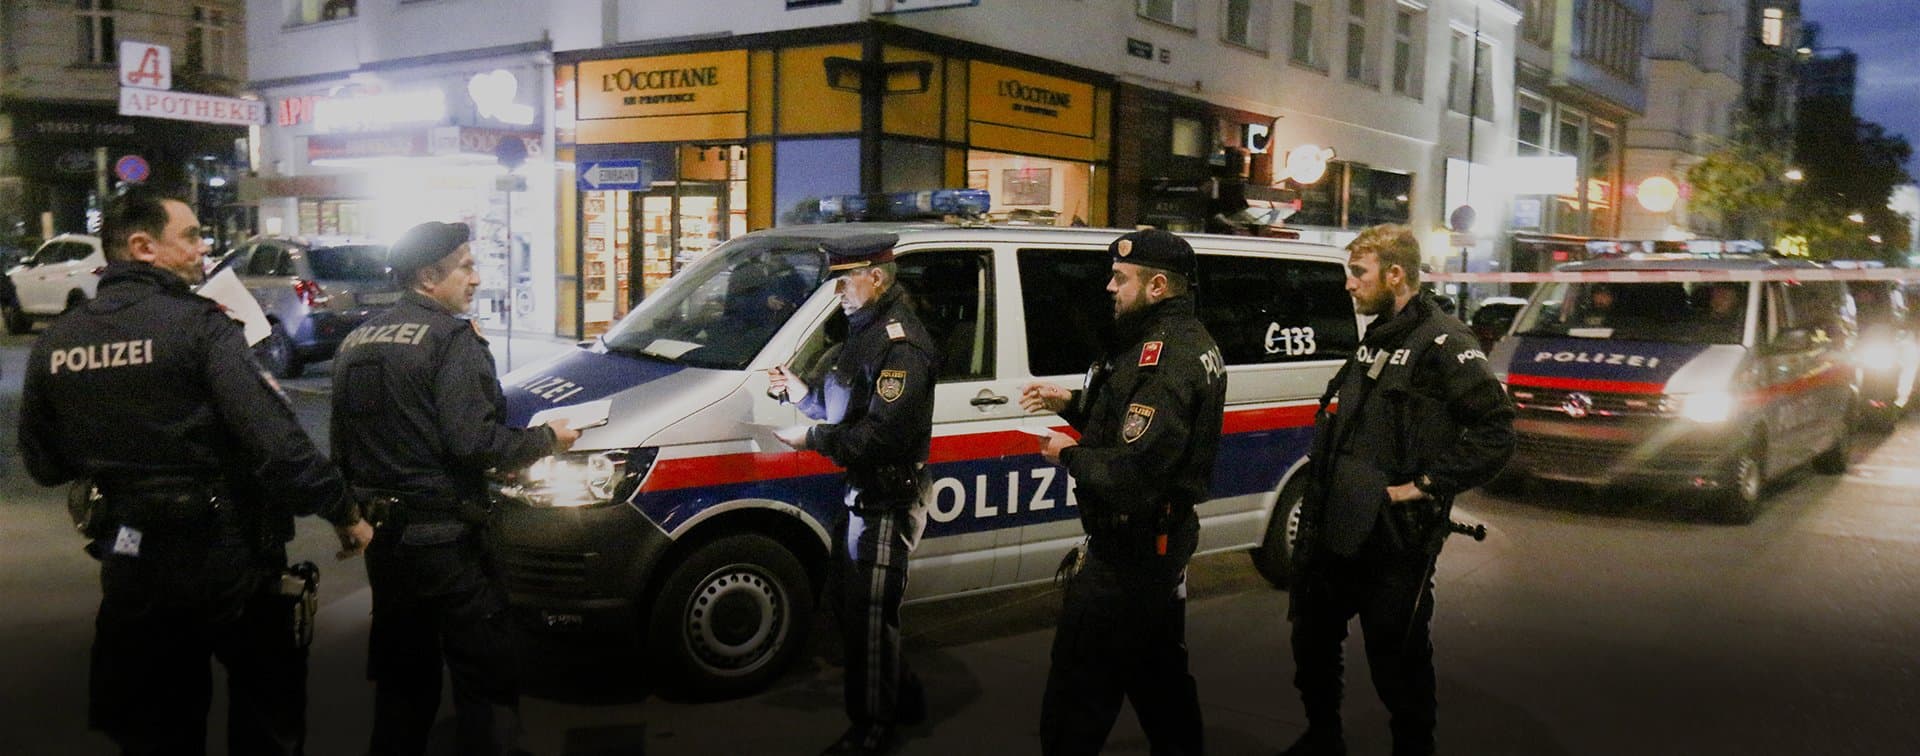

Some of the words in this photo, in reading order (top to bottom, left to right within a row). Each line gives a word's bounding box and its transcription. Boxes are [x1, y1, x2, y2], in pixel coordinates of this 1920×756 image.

[602, 66, 719, 92] L'OCCITANE
[128, 93, 260, 122] APOTHEKE
[639, 93, 696, 104] PROVENCE
[998, 79, 1072, 109] L'OCCITANE
[1280, 326, 1317, 356] 133
[50, 339, 154, 375] POLIZEI
[1533, 350, 1660, 369] POLIZEI
